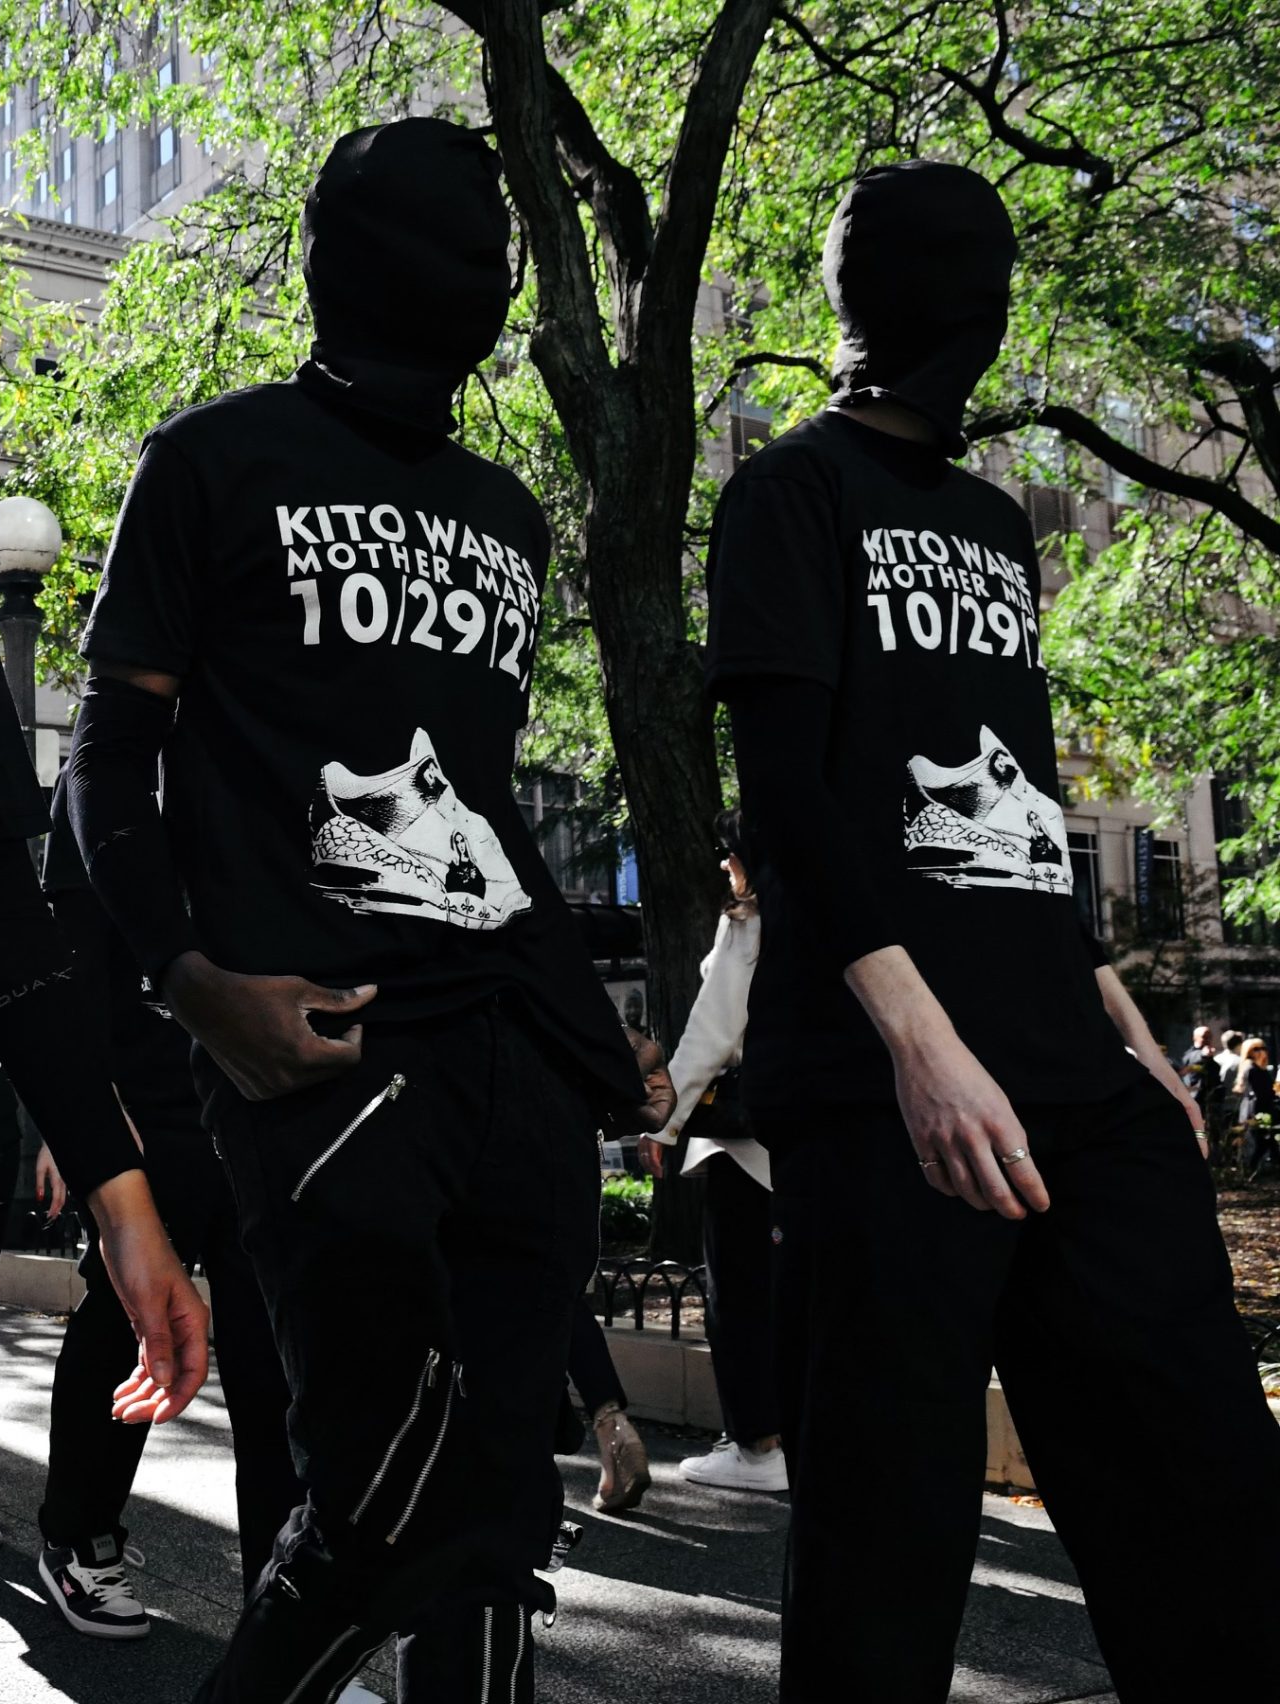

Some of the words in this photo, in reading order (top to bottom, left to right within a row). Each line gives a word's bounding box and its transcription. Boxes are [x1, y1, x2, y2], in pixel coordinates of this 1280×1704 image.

[276, 504, 406, 546] KITO
[415, 510, 539, 599] WARES
[287, 541, 454, 585] MOTHER
[476, 563, 540, 625] MARY
[862, 528, 950, 564] KITO
[950, 535, 1032, 598] WARE
[867, 563, 991, 598] MOTHER
